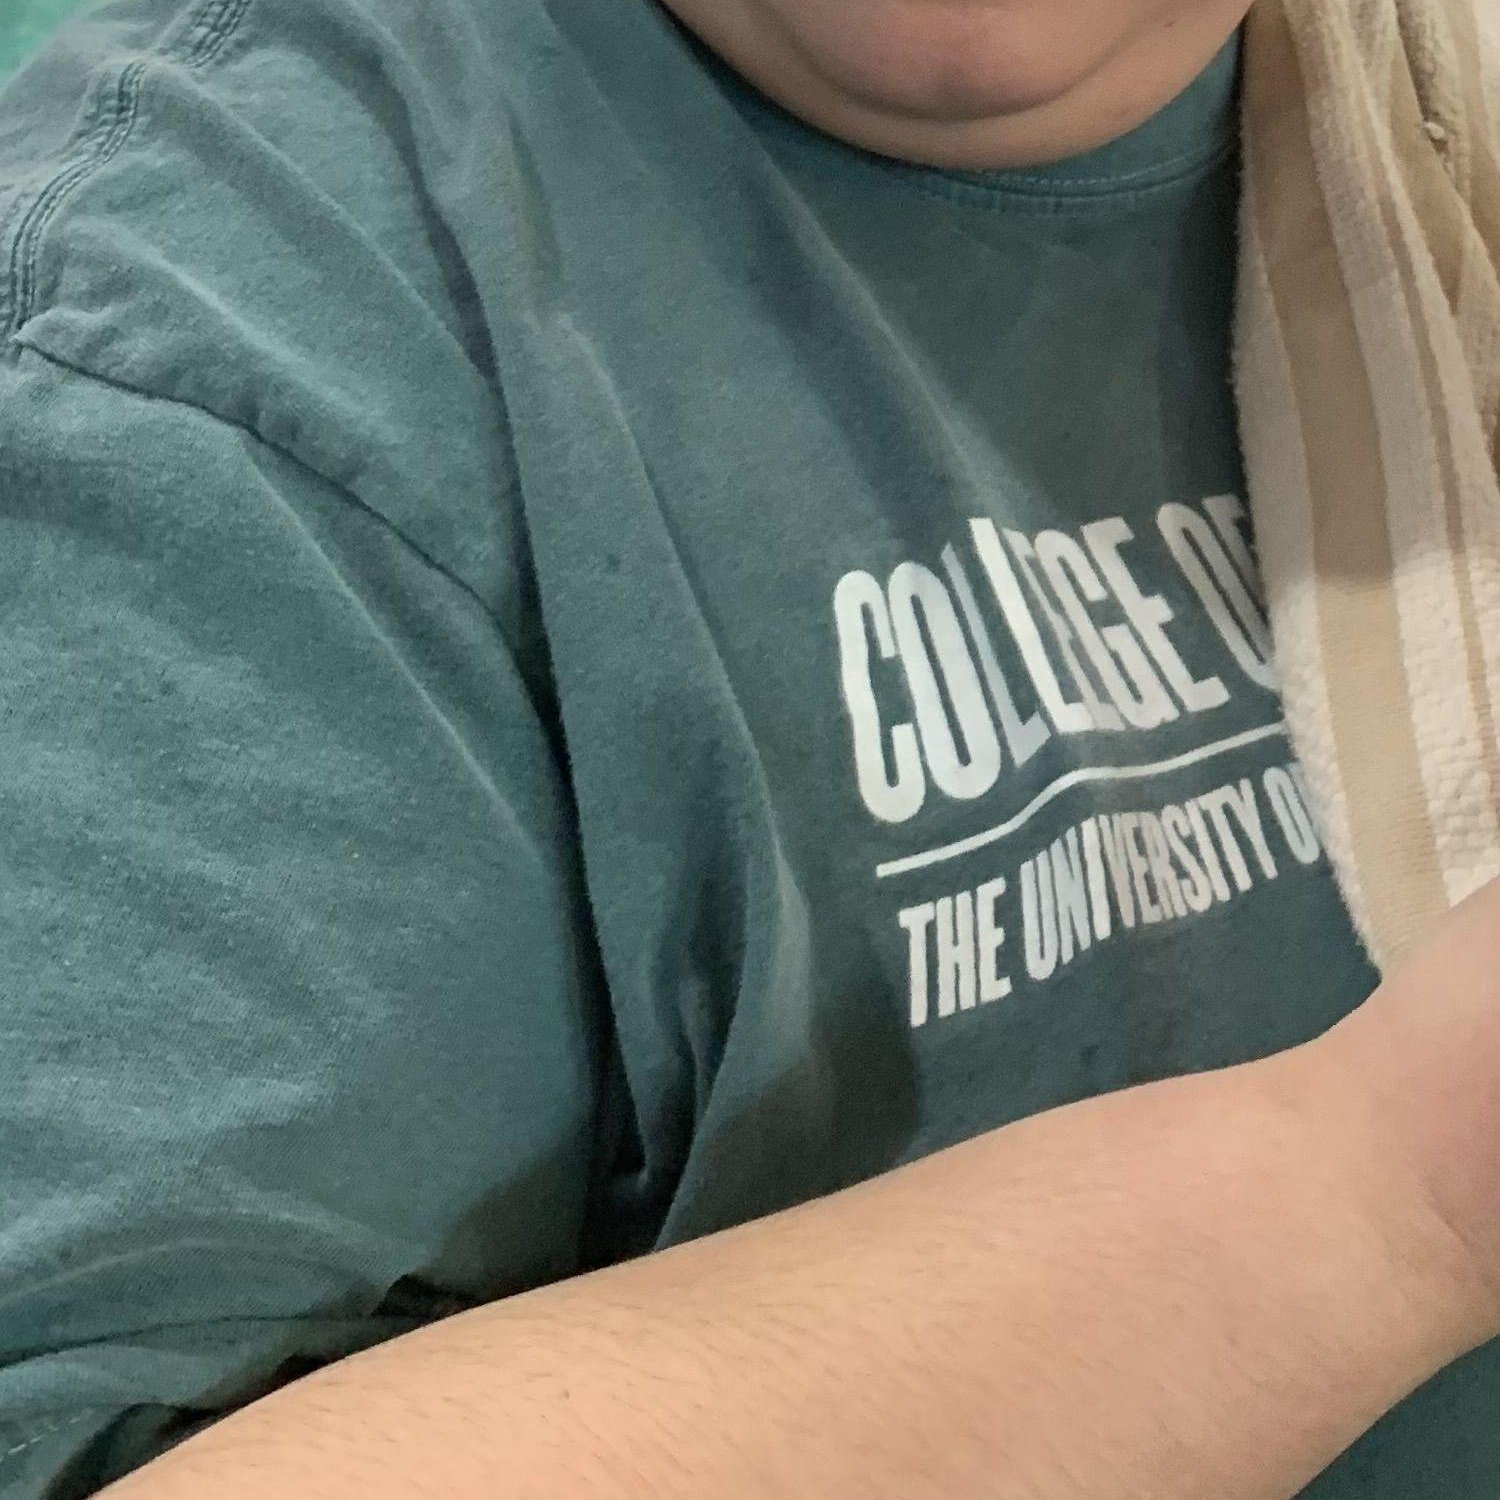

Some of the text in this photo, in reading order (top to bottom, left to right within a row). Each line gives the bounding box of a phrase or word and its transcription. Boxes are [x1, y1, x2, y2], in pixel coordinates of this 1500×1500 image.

[898, 762, 1321, 1028] THE UNIVERSITY O
